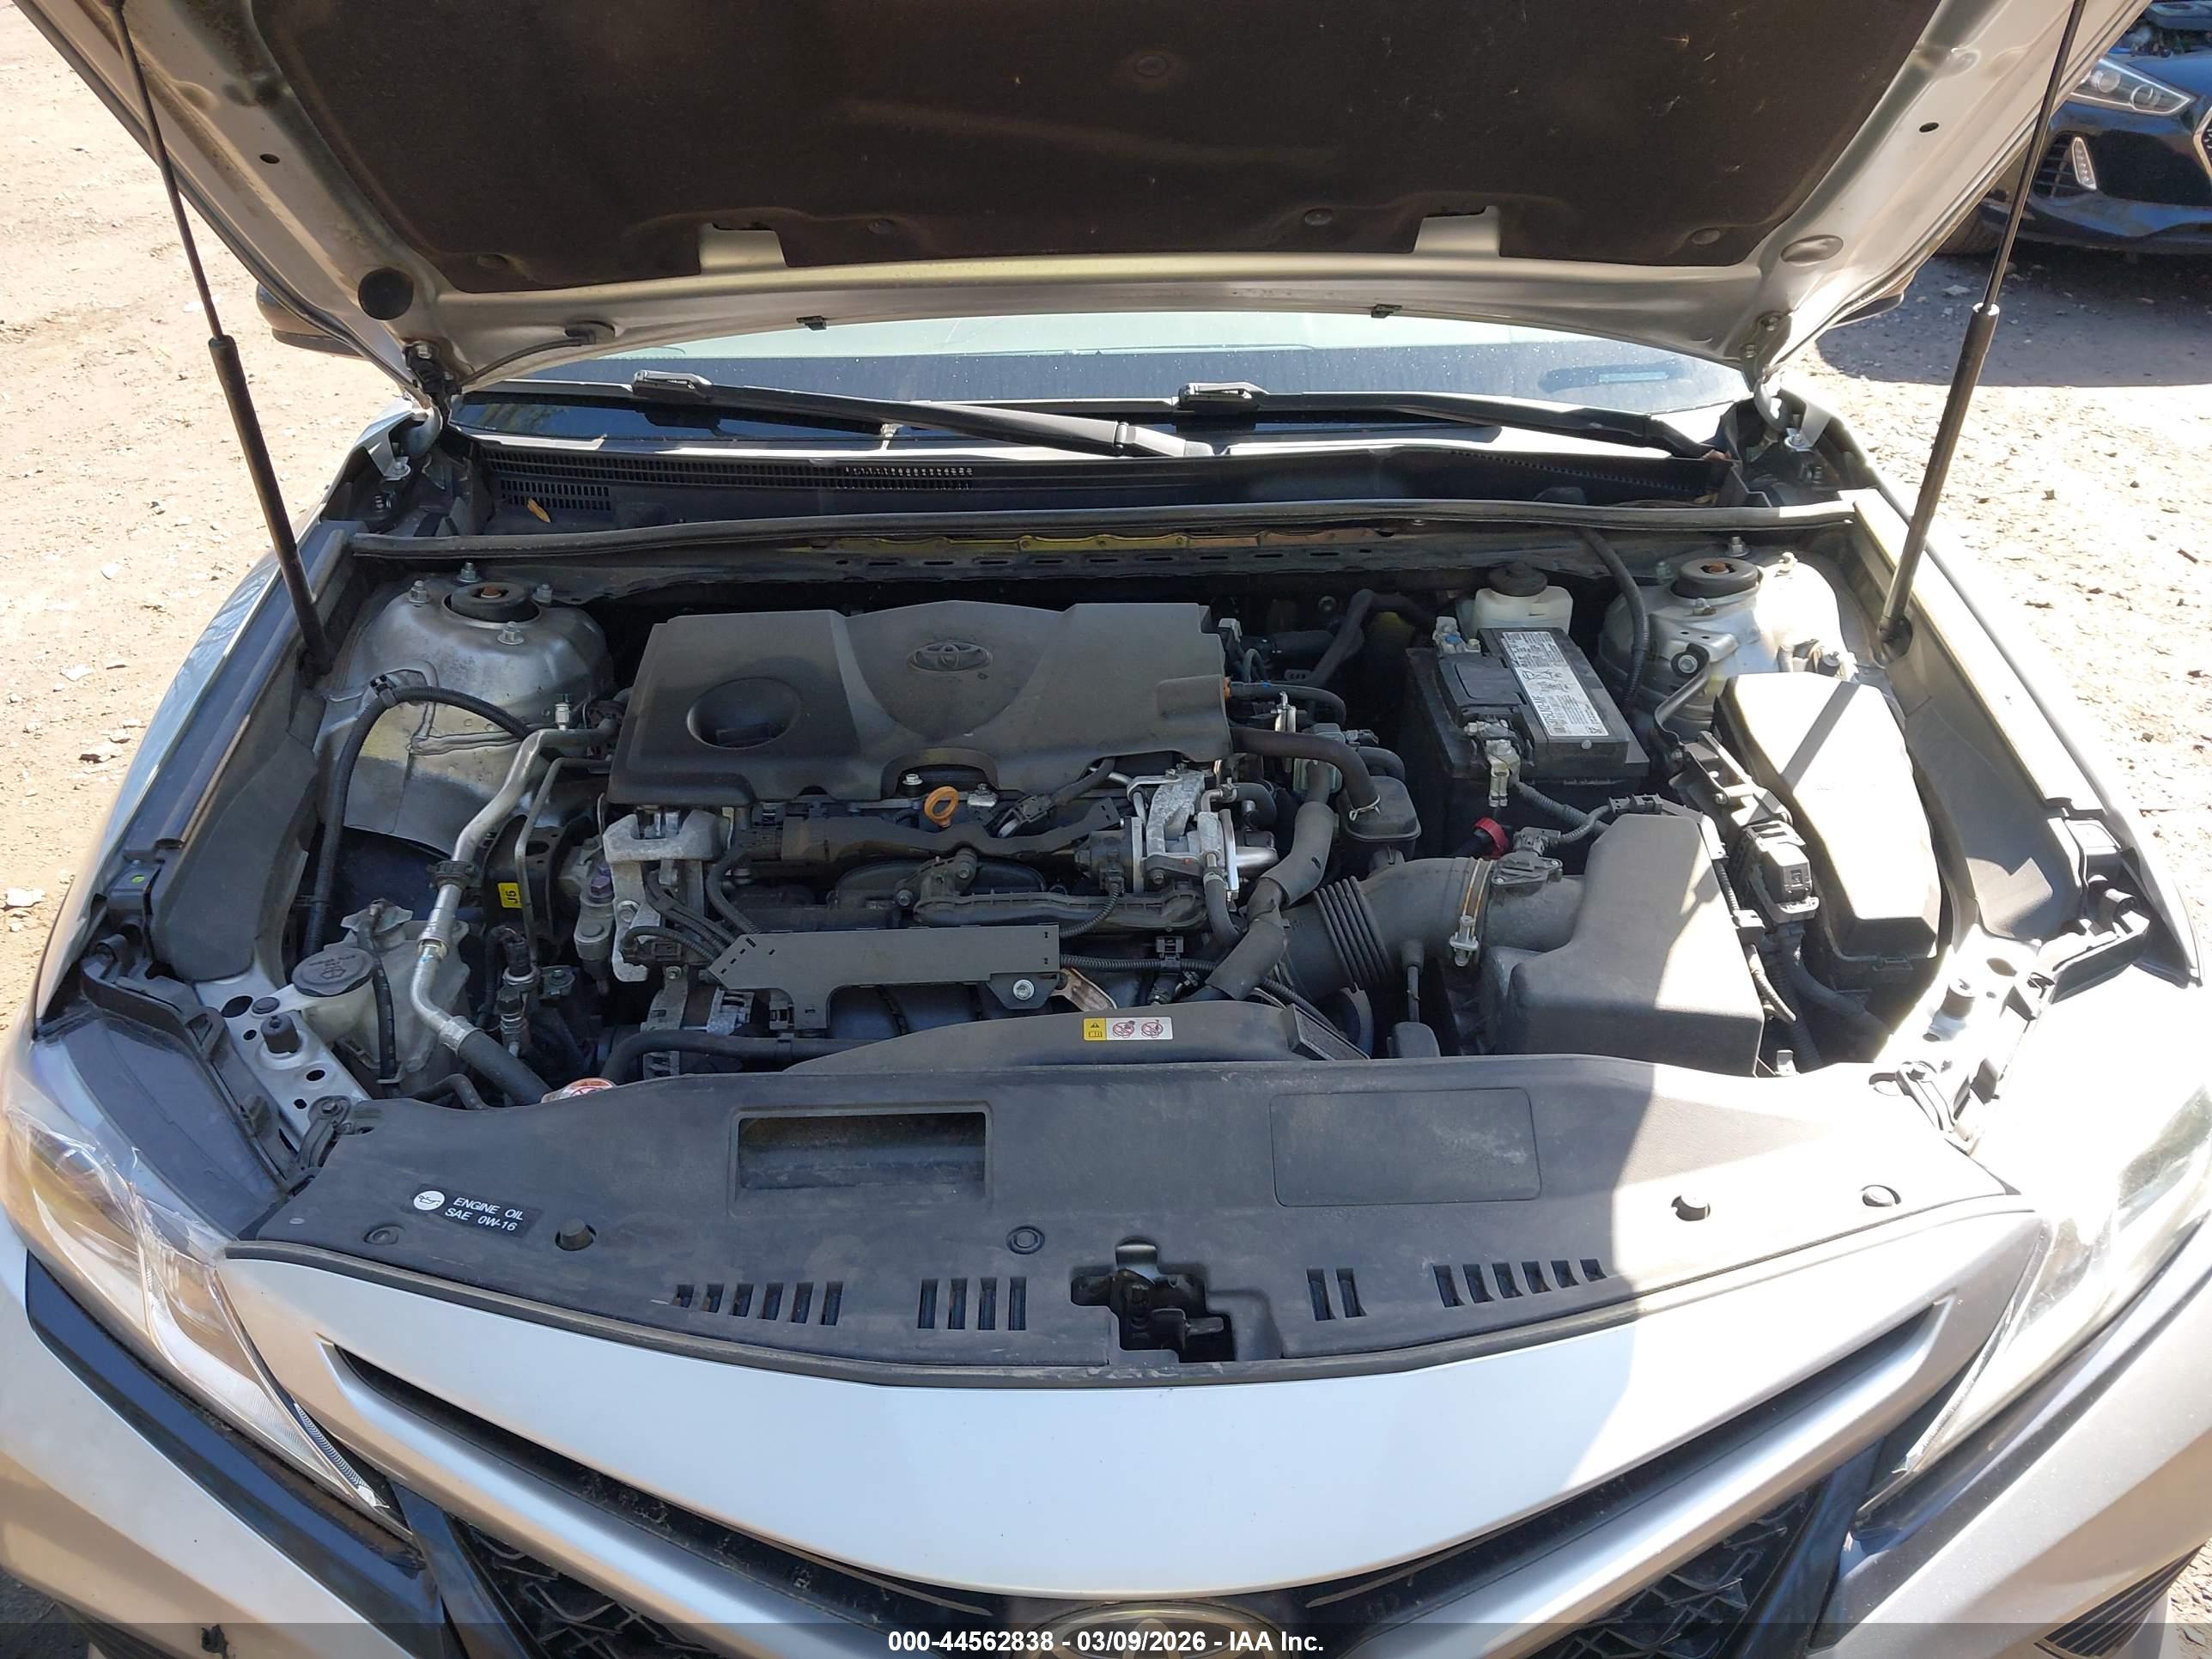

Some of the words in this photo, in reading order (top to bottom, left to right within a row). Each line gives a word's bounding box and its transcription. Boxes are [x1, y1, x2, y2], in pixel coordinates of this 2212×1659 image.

[445, 1207, 473, 1221] SAE
[477, 1215, 518, 1231] 0W-16
[453, 1197, 501, 1214] ENGINE
[505, 1208, 524, 1221] OIL
